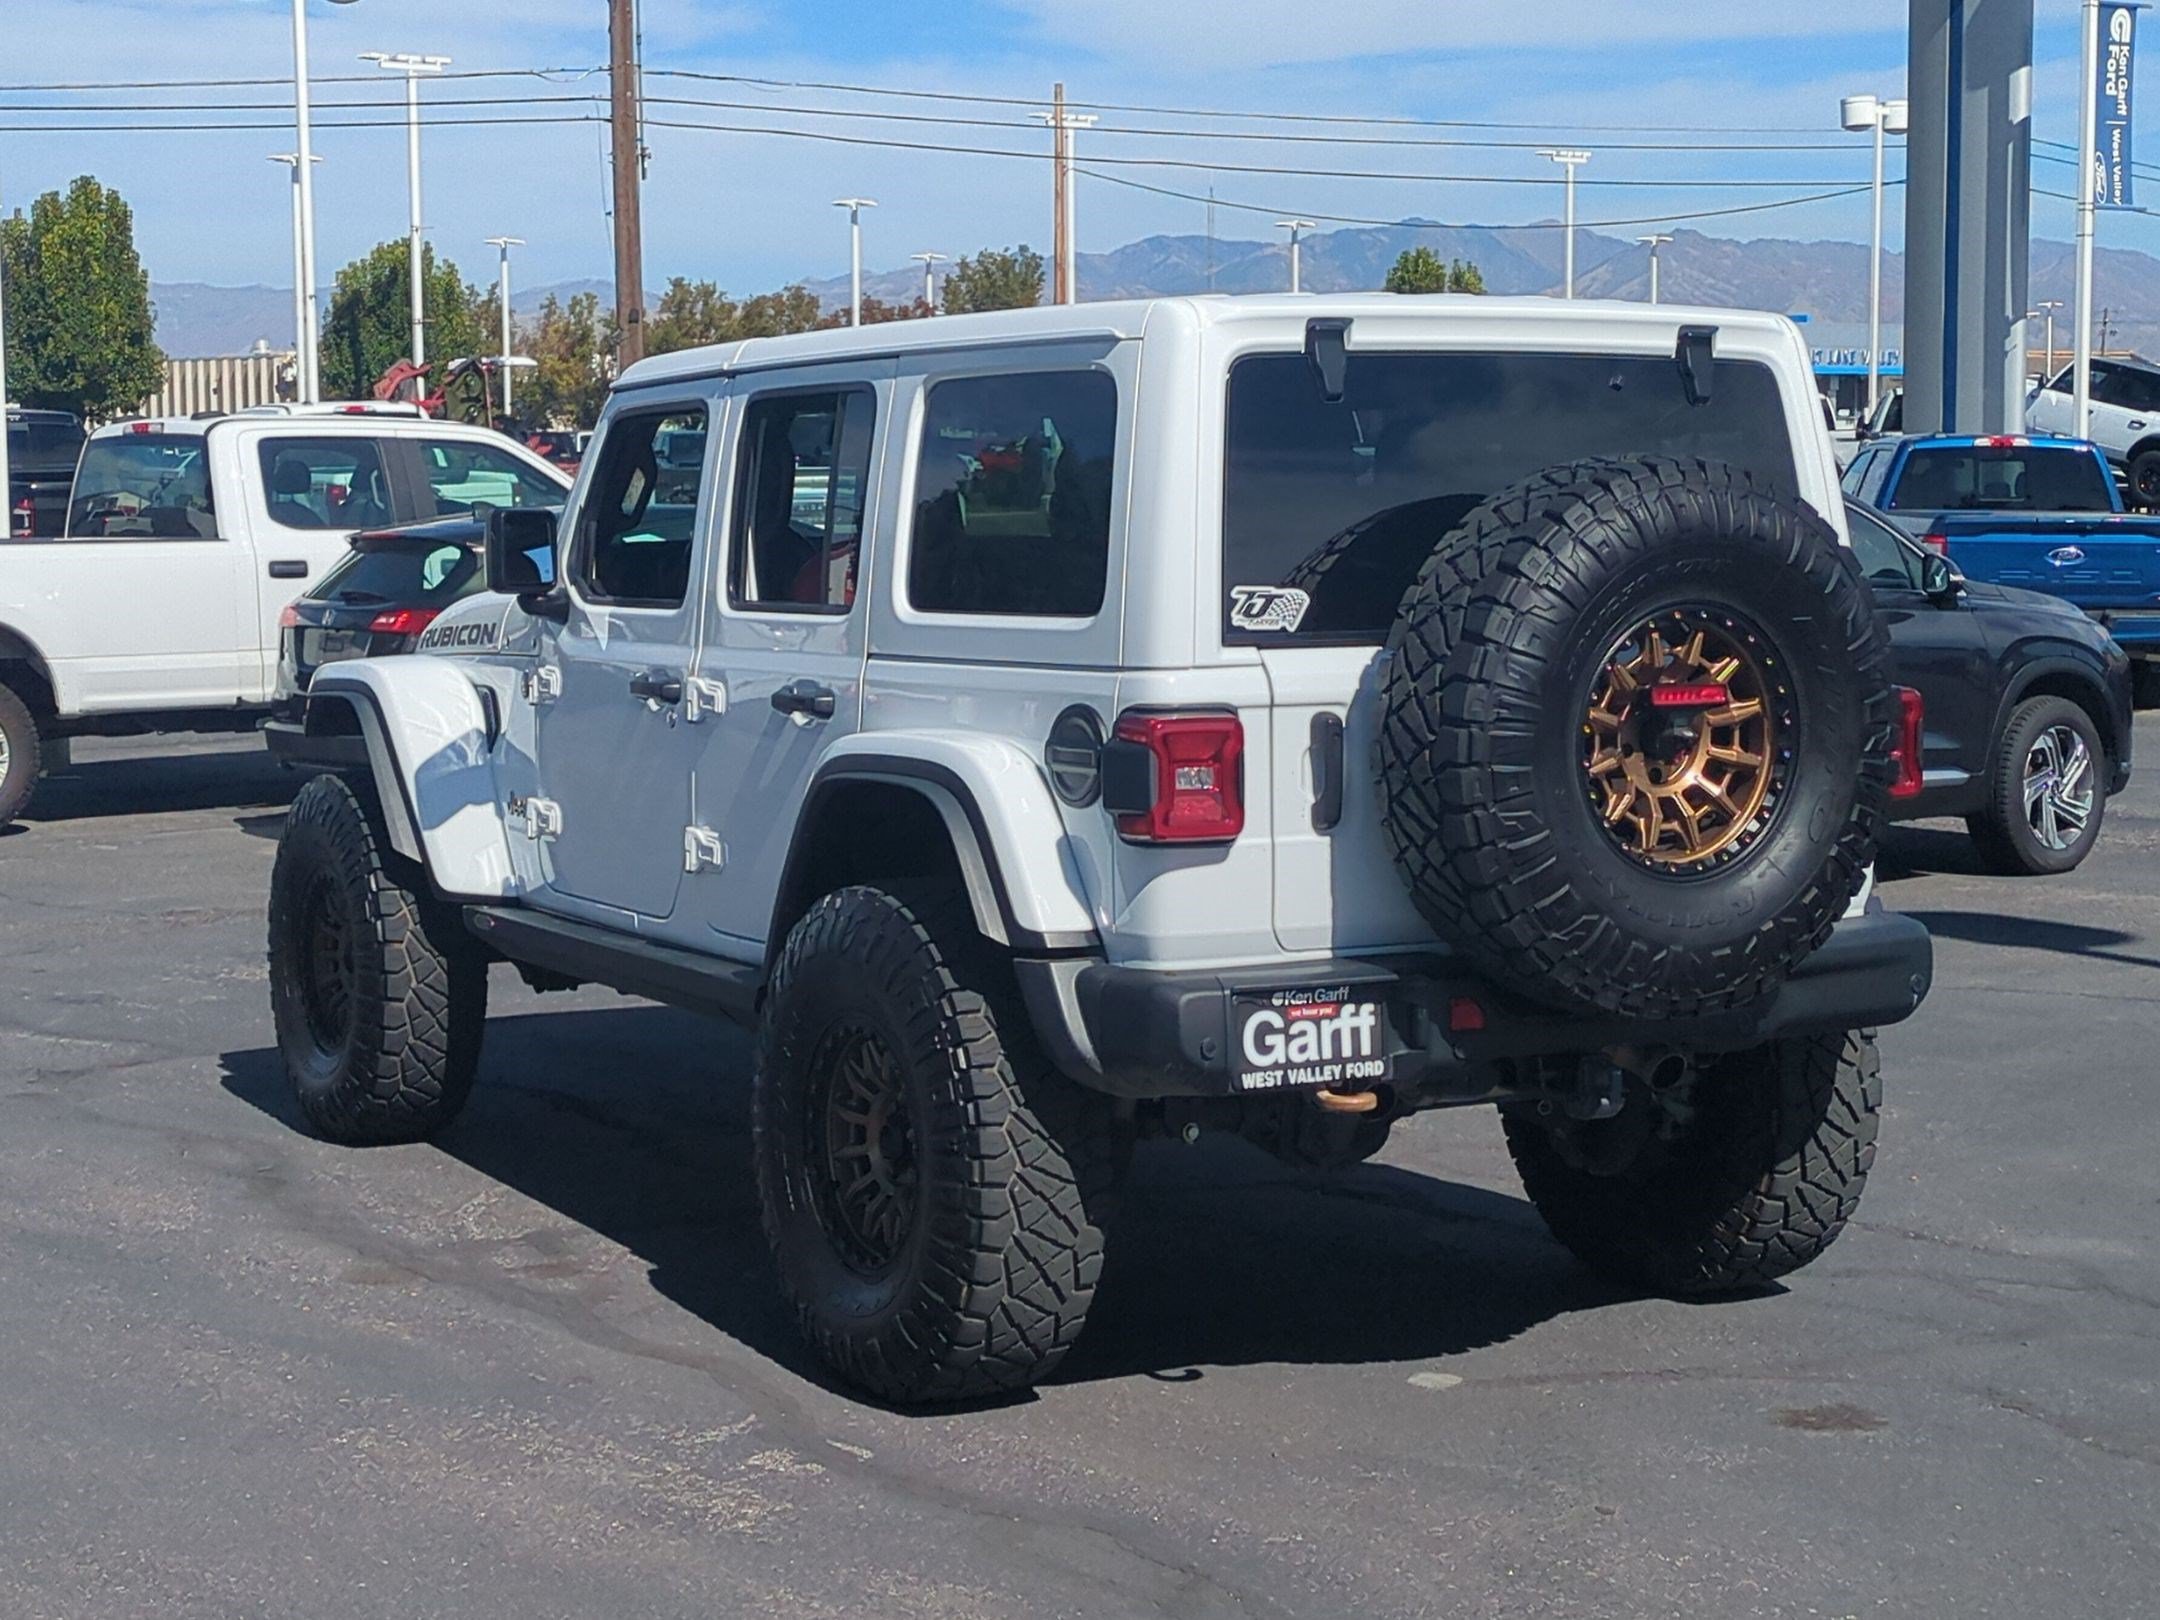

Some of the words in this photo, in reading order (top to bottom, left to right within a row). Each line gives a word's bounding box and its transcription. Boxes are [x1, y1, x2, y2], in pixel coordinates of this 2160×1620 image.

[2105, 44, 2120, 96] Ford
[2118, 45, 2130, 76] Ken
[2117, 78, 2128, 116] Garff
[2112, 128, 2121, 162] West
[2113, 165, 2122, 206] Valley
[1860, 348, 1899, 366] VLEY
[420, 622, 497, 649] RUBICON
[1285, 990, 1312, 1006] Ken
[1314, 986, 1350, 1004] Garff
[1243, 1003, 1375, 1067] Garff
[1241, 1071, 1284, 1090] WEST
[1287, 1064, 1341, 1084] VALLEY
[1346, 1060, 1385, 1079] FORD
